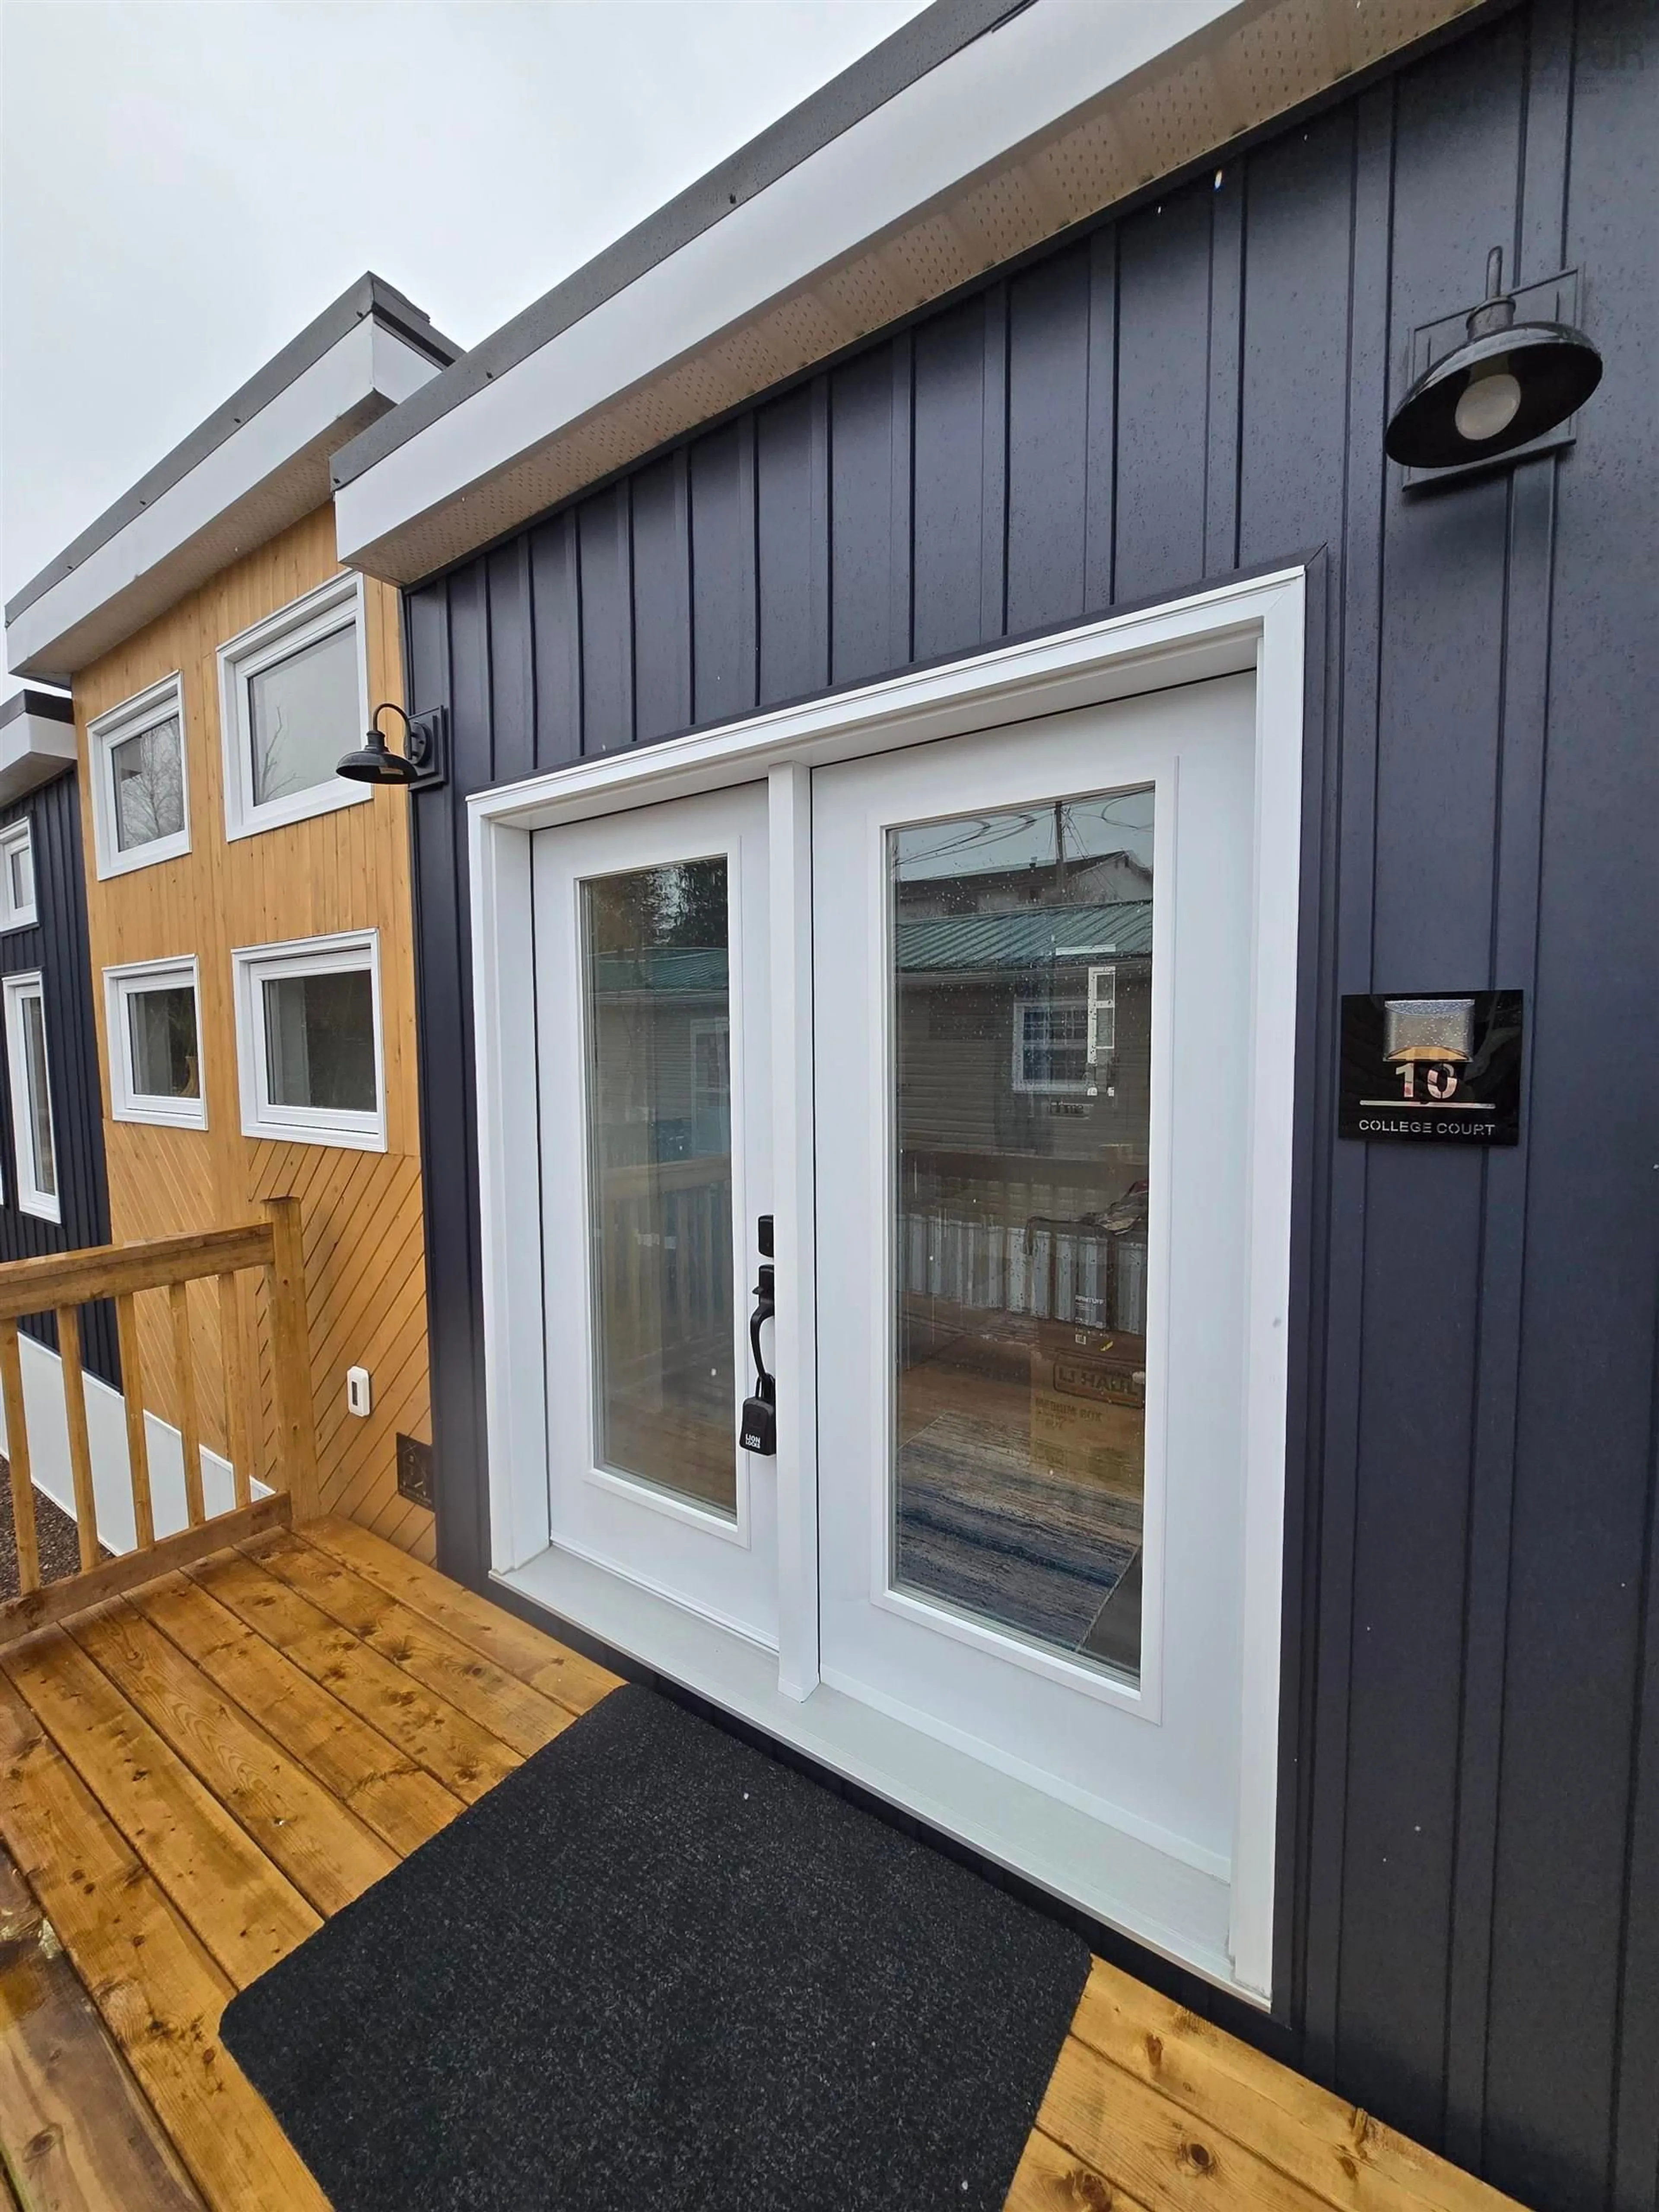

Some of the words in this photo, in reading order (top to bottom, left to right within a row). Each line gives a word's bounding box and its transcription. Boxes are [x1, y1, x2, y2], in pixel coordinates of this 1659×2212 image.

[1396, 1062, 1458, 1099] 10
[1359, 1120, 1432, 1133] COLLEGE
[1436, 1123, 1495, 1135] COURT
[746, 1433, 760, 1443] LION
